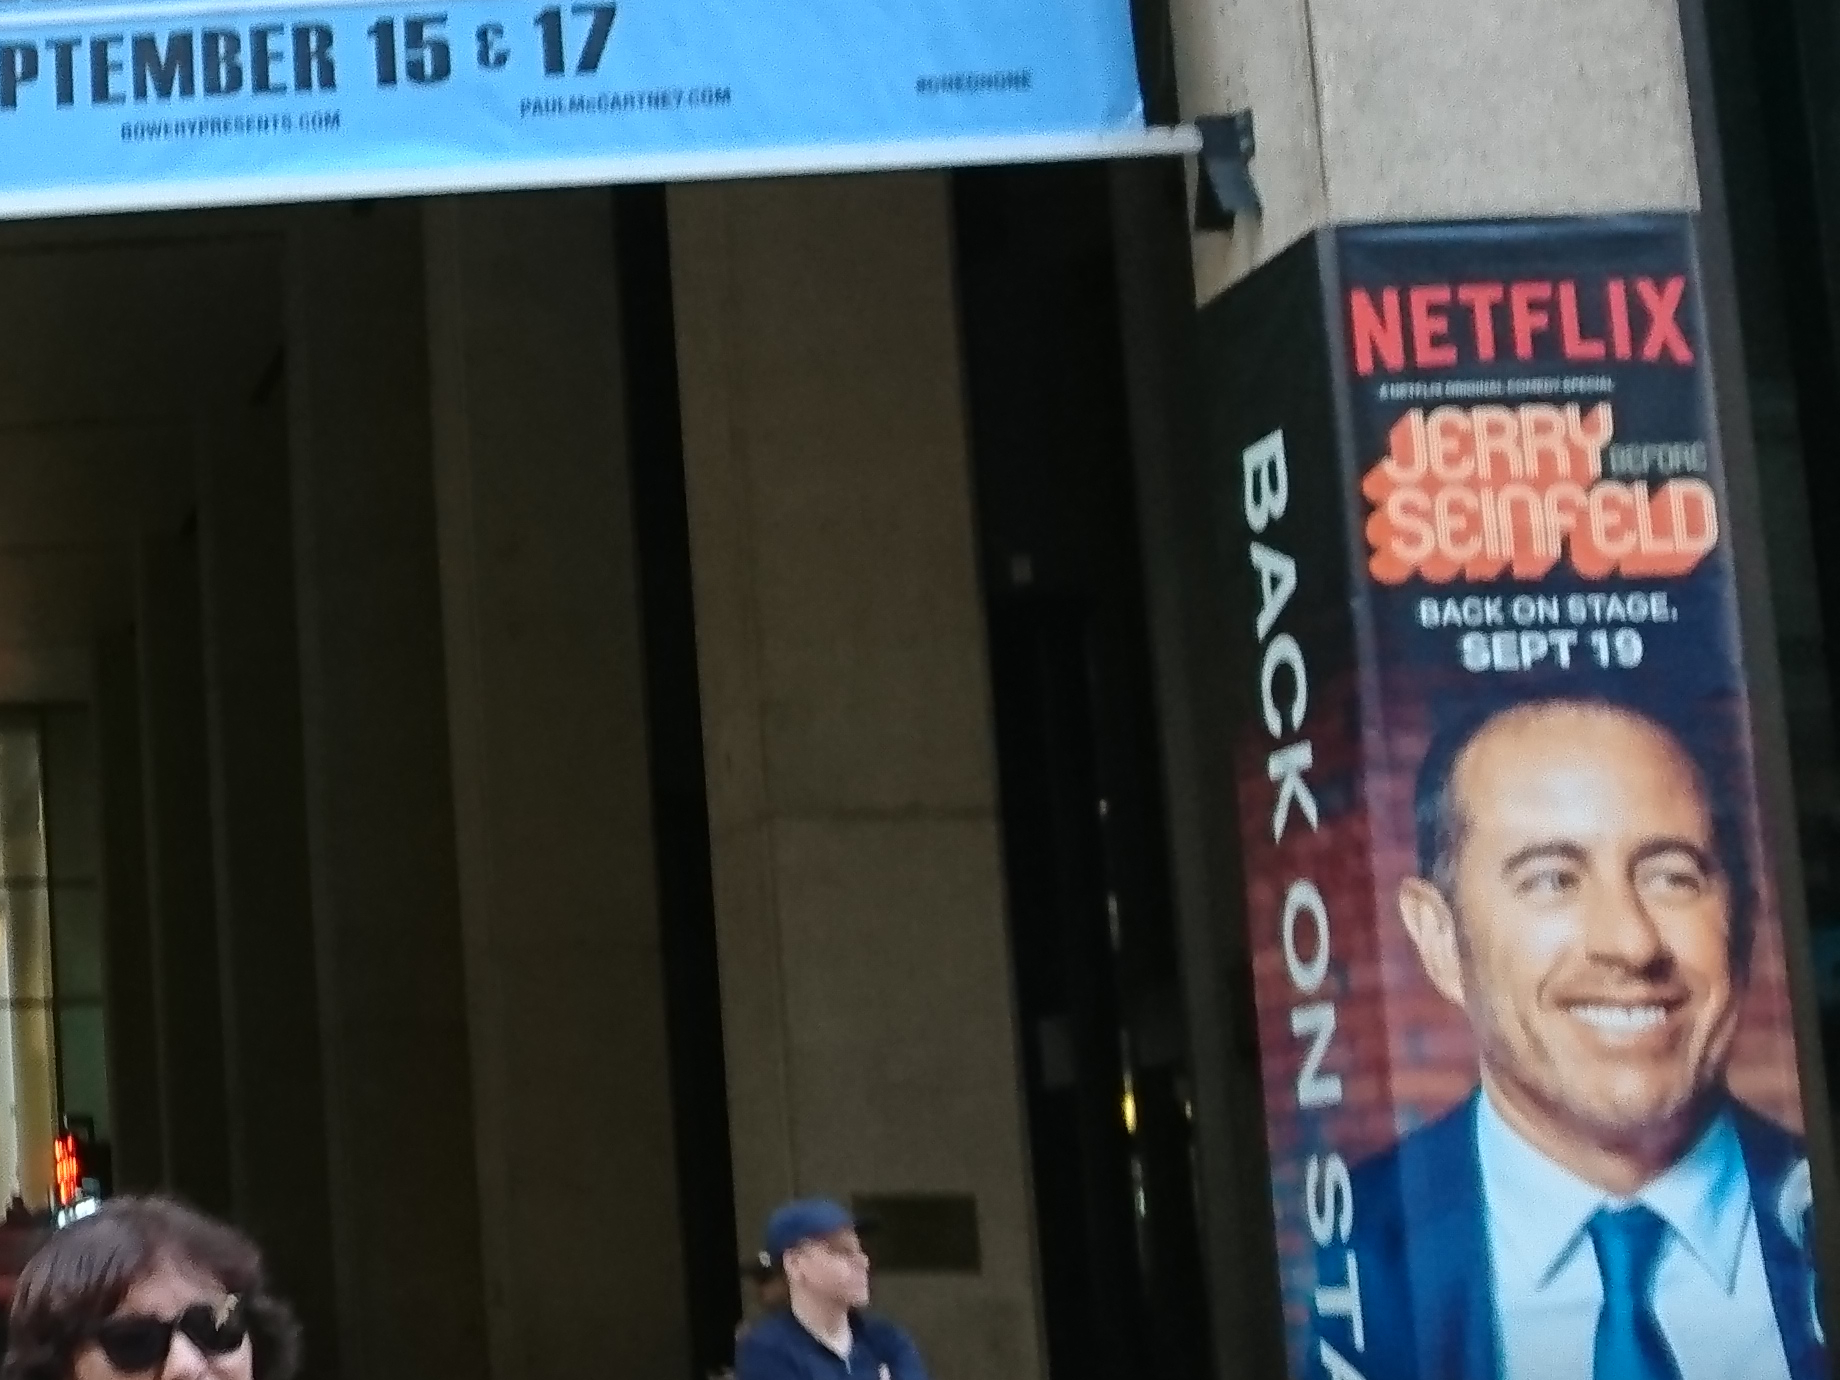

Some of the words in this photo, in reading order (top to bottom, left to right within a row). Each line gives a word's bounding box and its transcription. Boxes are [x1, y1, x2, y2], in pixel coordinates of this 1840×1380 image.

[369, 16, 453, 86] 15
[476, 28, 510, 72] &
[536, 4, 618, 77] 17
[1349, 275, 1696, 377] NETFLIX
[1364, 401, 1614, 488] JERRY
[1366, 478, 1719, 586] SEINFELD
[1420, 593, 1505, 629] BACK
[1512, 593, 1560, 627] ON
[1461, 629, 1579, 673] SEPT
[1242, 427, 1320, 846] BACK
[1283, 877, 1343, 1110] ON
